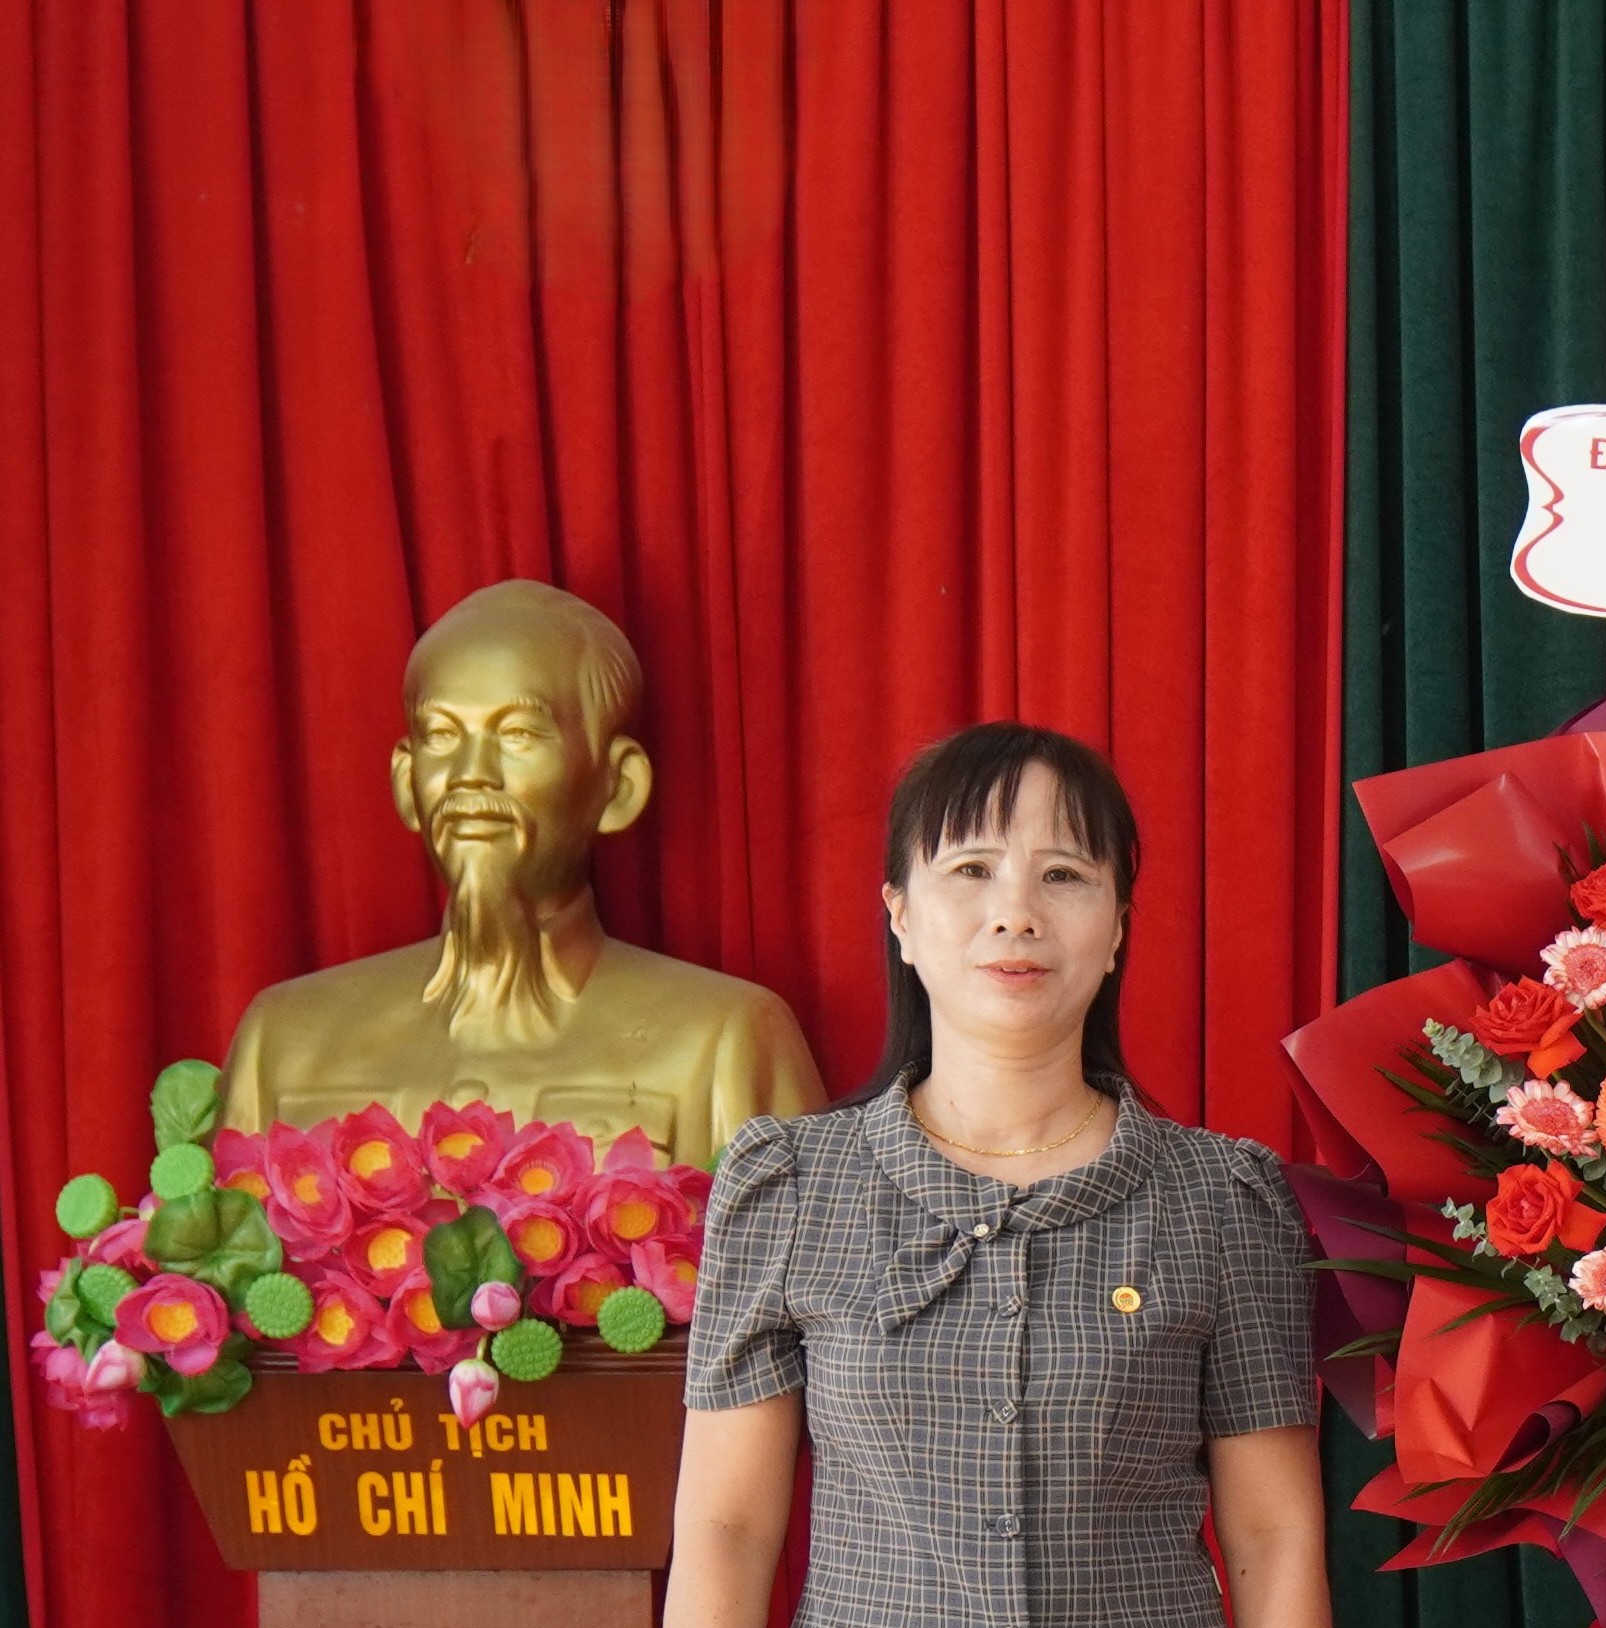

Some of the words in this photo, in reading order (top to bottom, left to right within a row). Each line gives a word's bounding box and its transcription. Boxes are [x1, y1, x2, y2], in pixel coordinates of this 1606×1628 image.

[318, 1397, 413, 1451] CHỦ
[438, 1413, 548, 1459] TỊCH
[245, 1453, 318, 1537] HỒ
[356, 1459, 447, 1537] CHÍ
[489, 1472, 633, 1537] MINH
